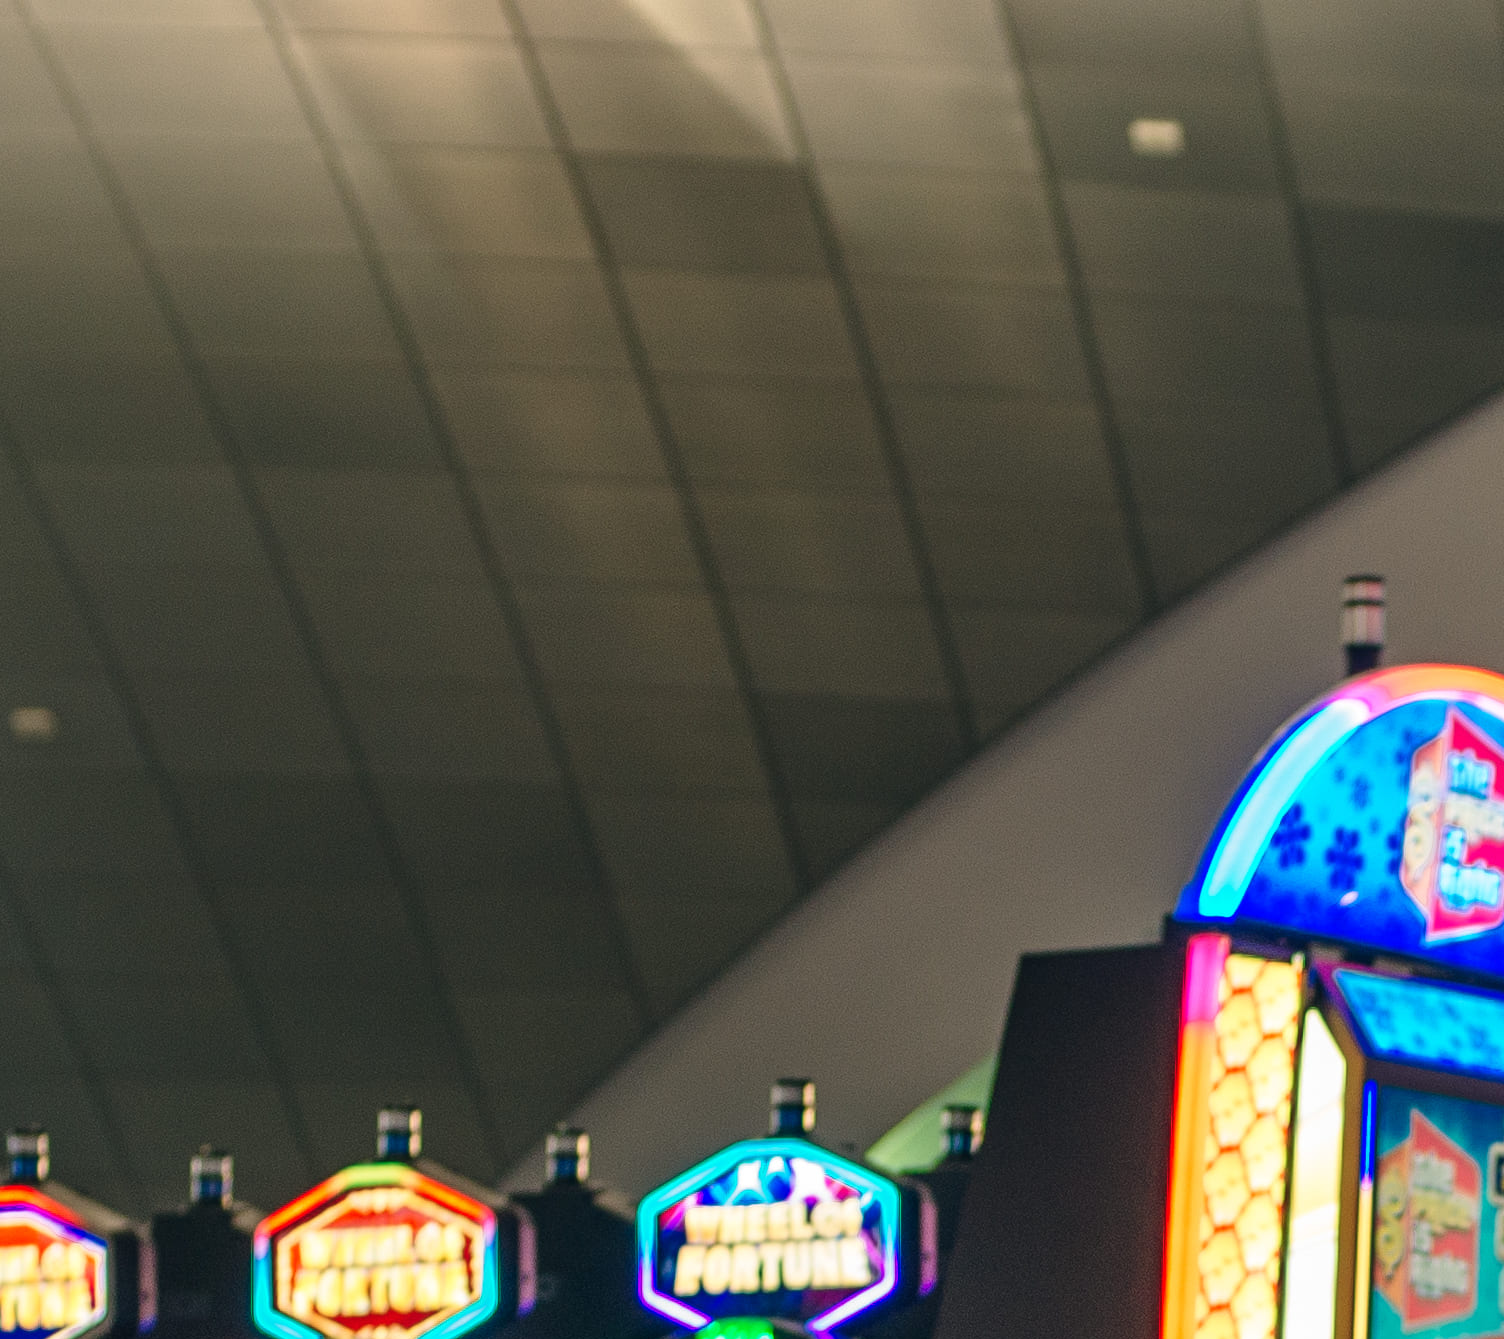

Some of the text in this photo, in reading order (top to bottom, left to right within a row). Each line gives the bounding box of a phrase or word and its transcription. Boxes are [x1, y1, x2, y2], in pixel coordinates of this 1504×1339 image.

[685, 1197, 862, 1244] WHEEL OF
[674, 1236, 872, 1296] FORTUNE
